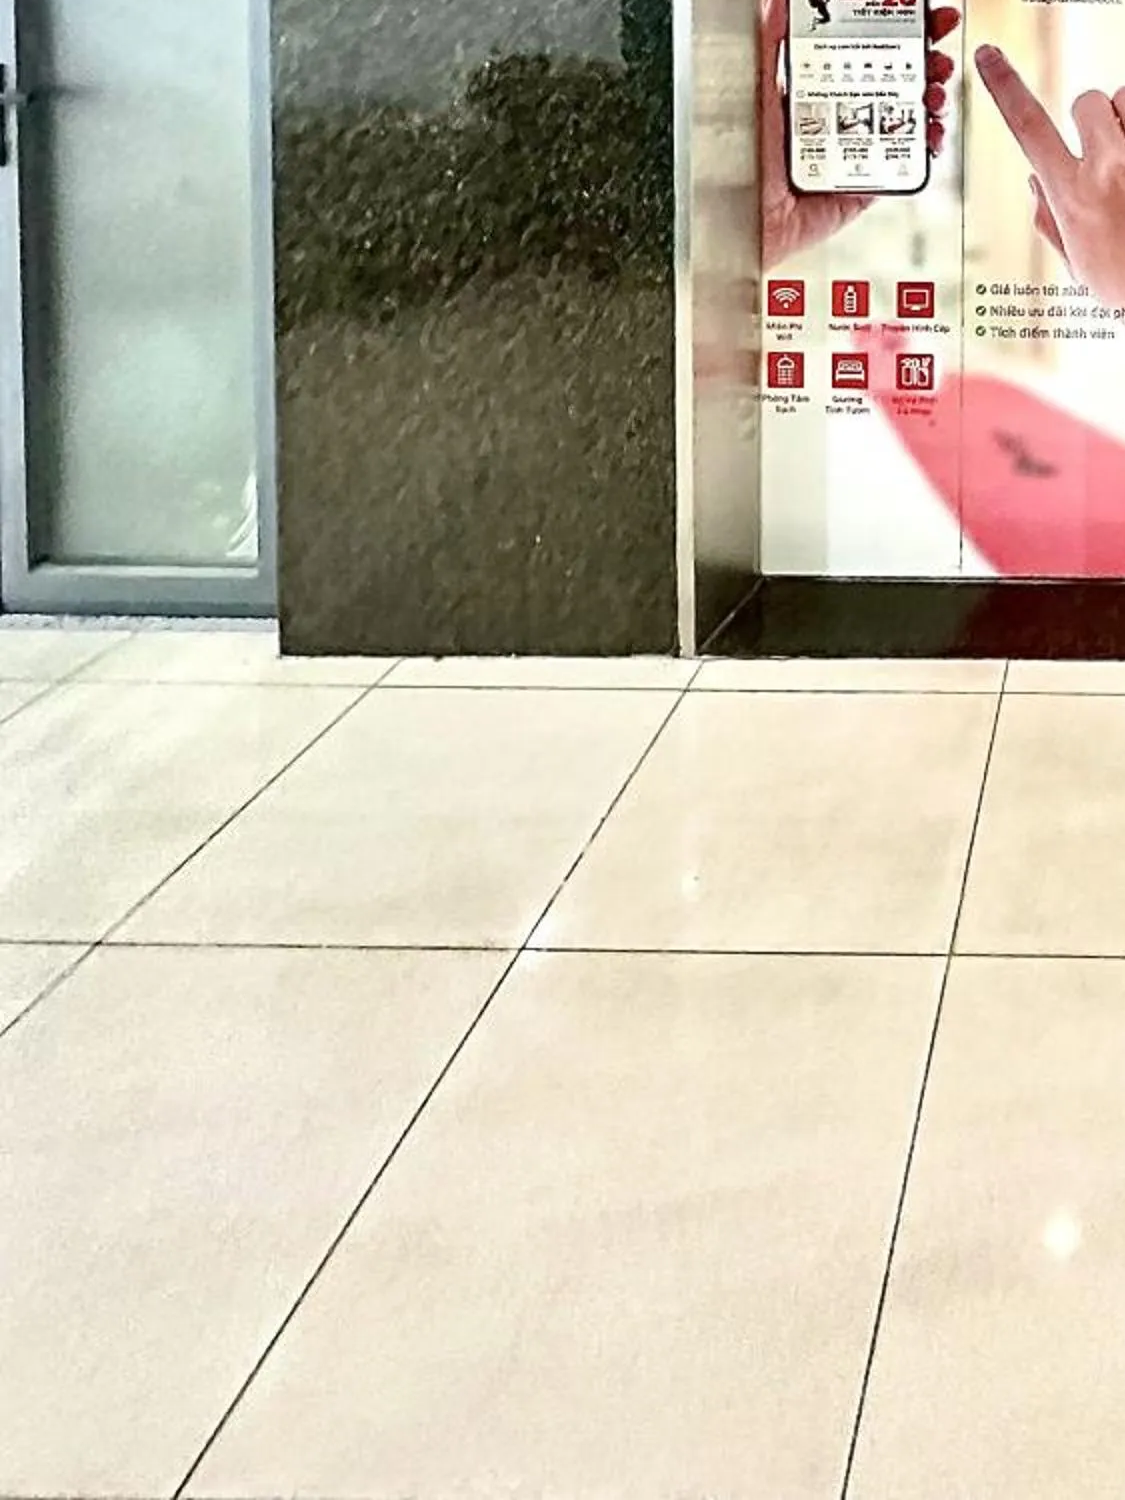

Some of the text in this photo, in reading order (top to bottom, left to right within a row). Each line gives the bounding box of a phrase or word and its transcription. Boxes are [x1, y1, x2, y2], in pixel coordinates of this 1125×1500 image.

[990, 283, 1010, 296] Giá
[1013, 283, 1040, 296] luôn
[1042, 283, 1059, 296] tốt
[990, 304, 1025, 317] Nhiều
[990, 326, 1016, 338] Tích
